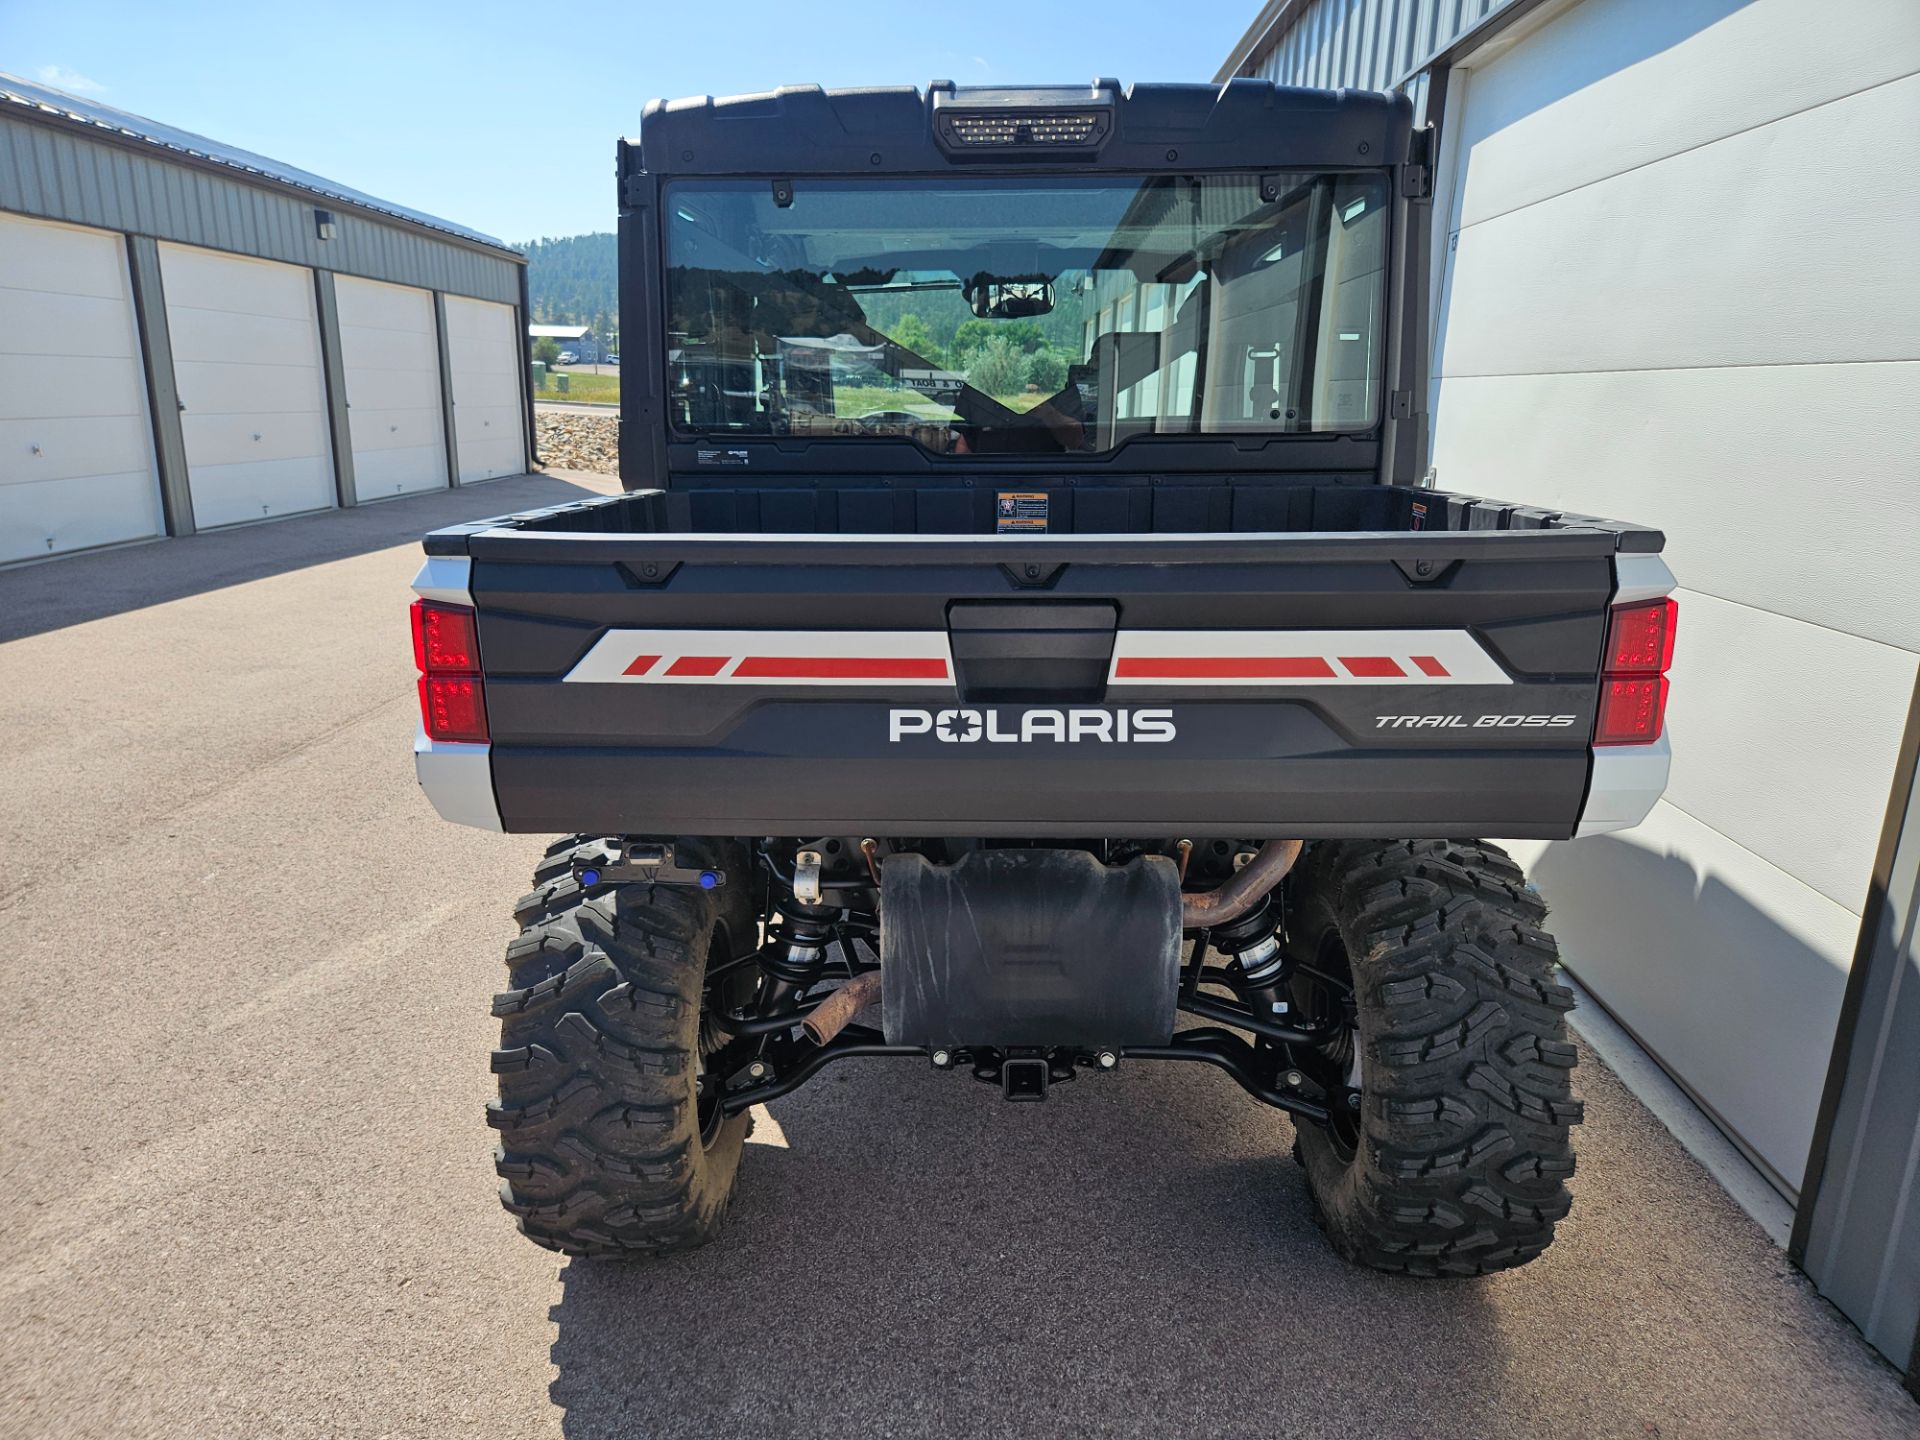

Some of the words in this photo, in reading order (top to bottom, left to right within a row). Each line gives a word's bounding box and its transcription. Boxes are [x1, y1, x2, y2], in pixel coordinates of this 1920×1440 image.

[889, 709, 1176, 742] POLARIS
[1376, 715, 1468, 728] TRAIL
[1472, 714, 1576, 728] BOSS
